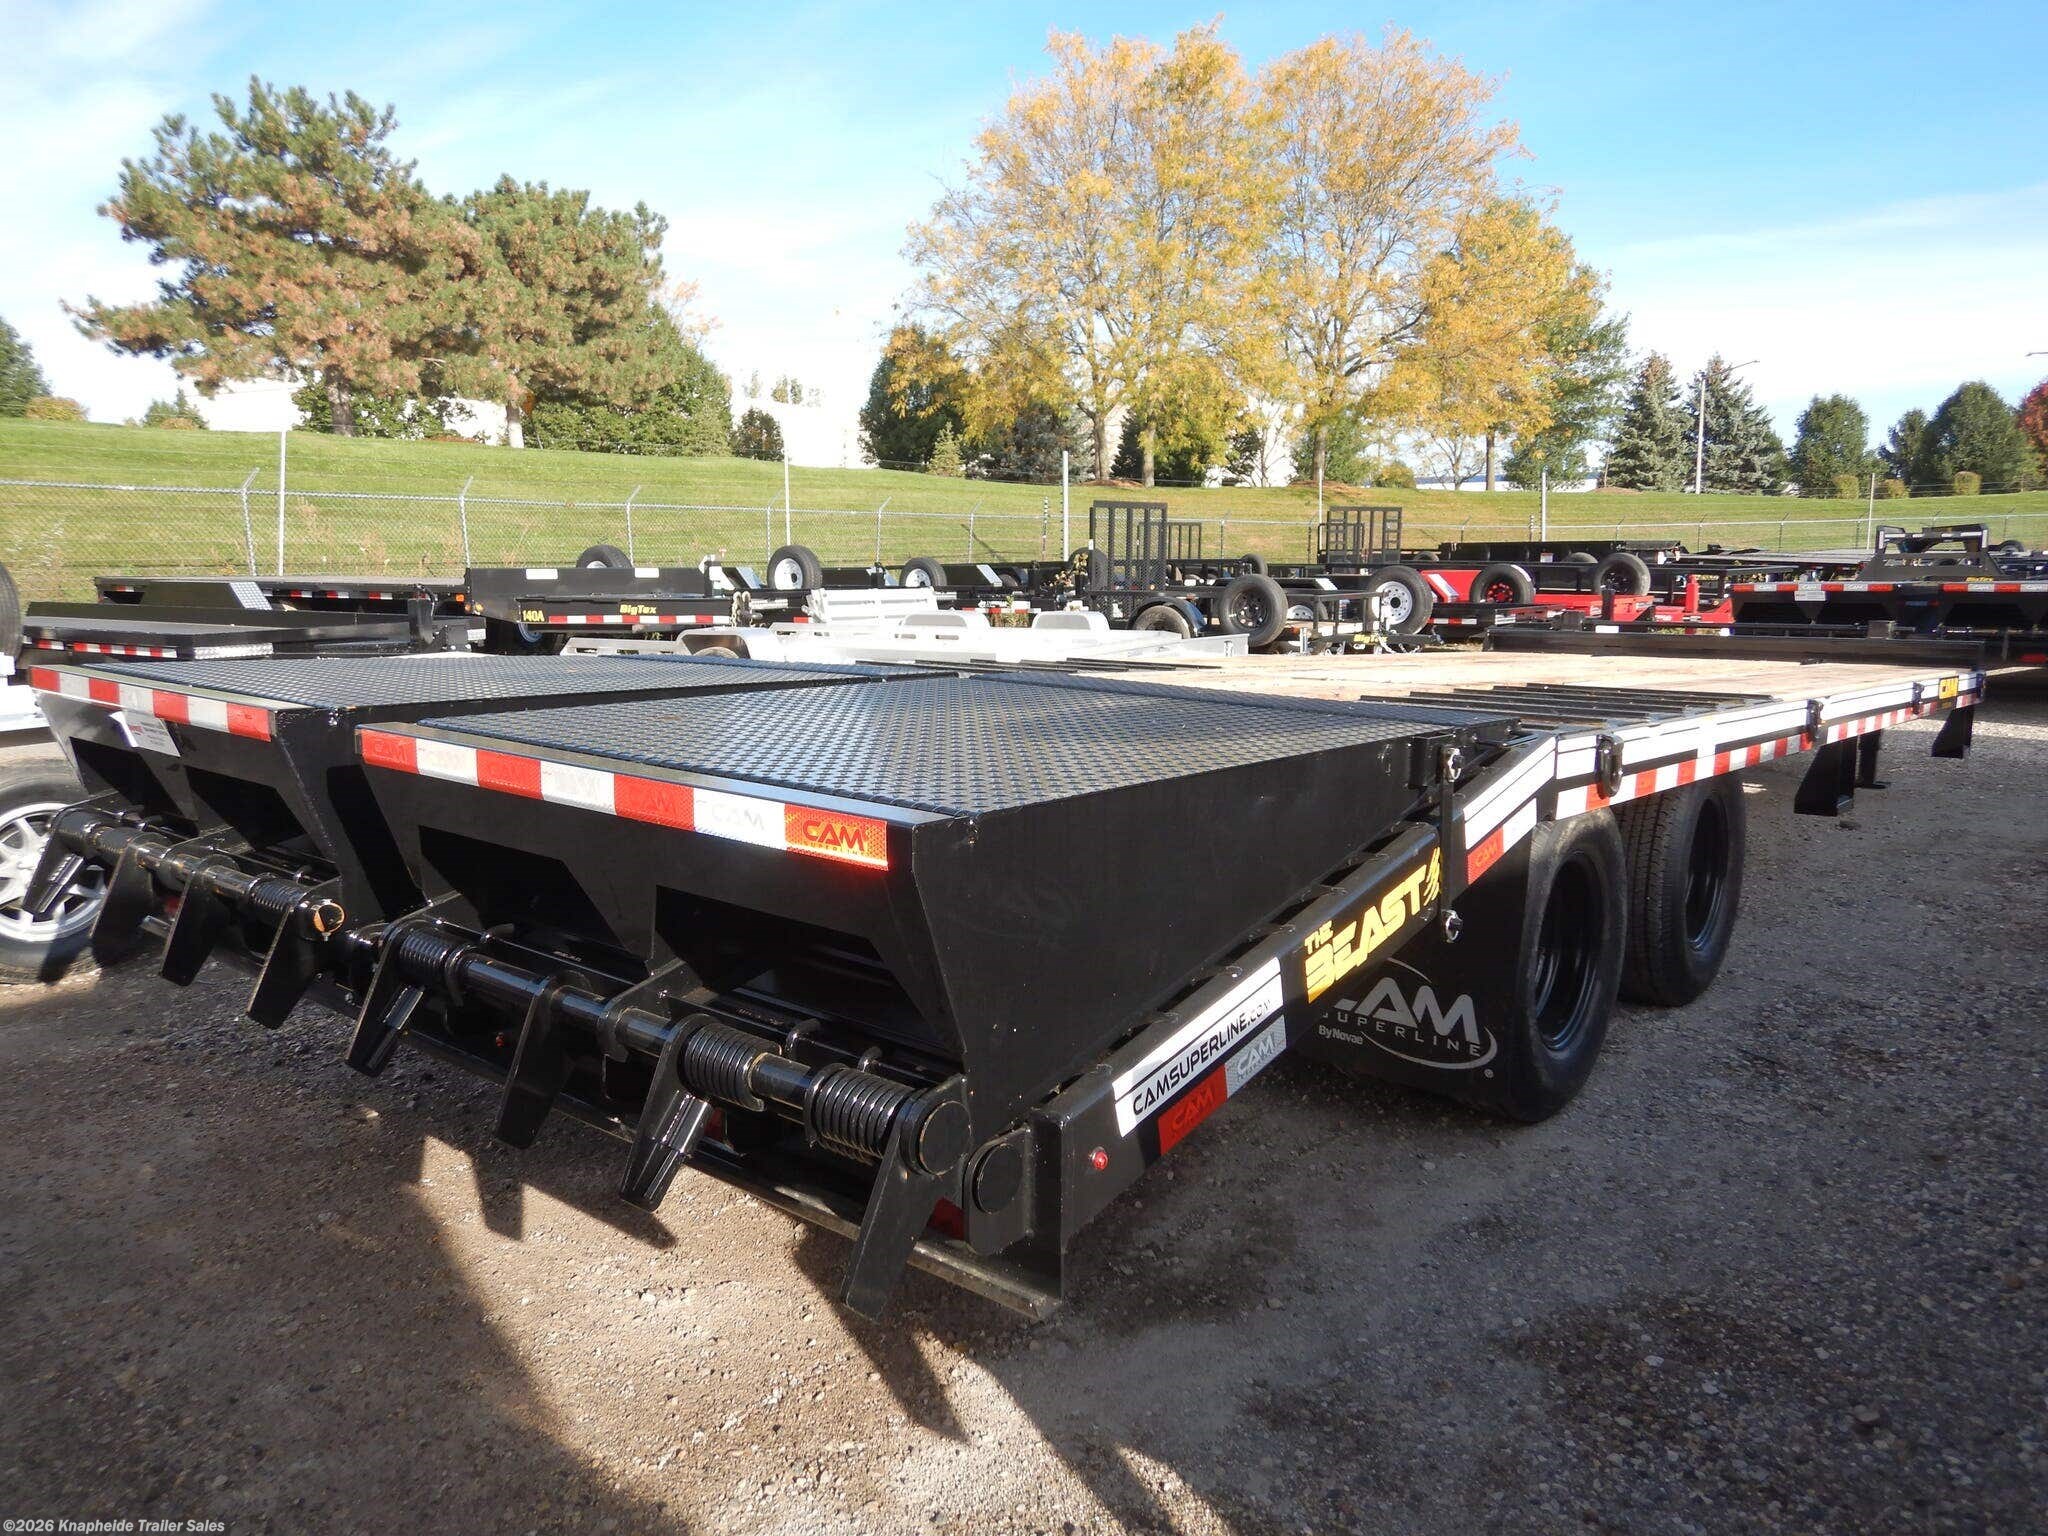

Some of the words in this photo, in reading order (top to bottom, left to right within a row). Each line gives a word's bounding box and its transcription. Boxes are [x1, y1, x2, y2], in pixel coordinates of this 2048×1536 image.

[522, 610, 545, 622] 140A
[619, 604, 657, 615] BigTex
[802, 819, 865, 852] CAM
[1475, 845, 1498, 867] CAM
[1304, 920, 1334, 955] THE
[1305, 864, 1428, 1005] BEAST
[1333, 976, 1480, 1045] AM
[1237, 1032, 1277, 1075] CAM
[1171, 1086, 1216, 1129] CAM
